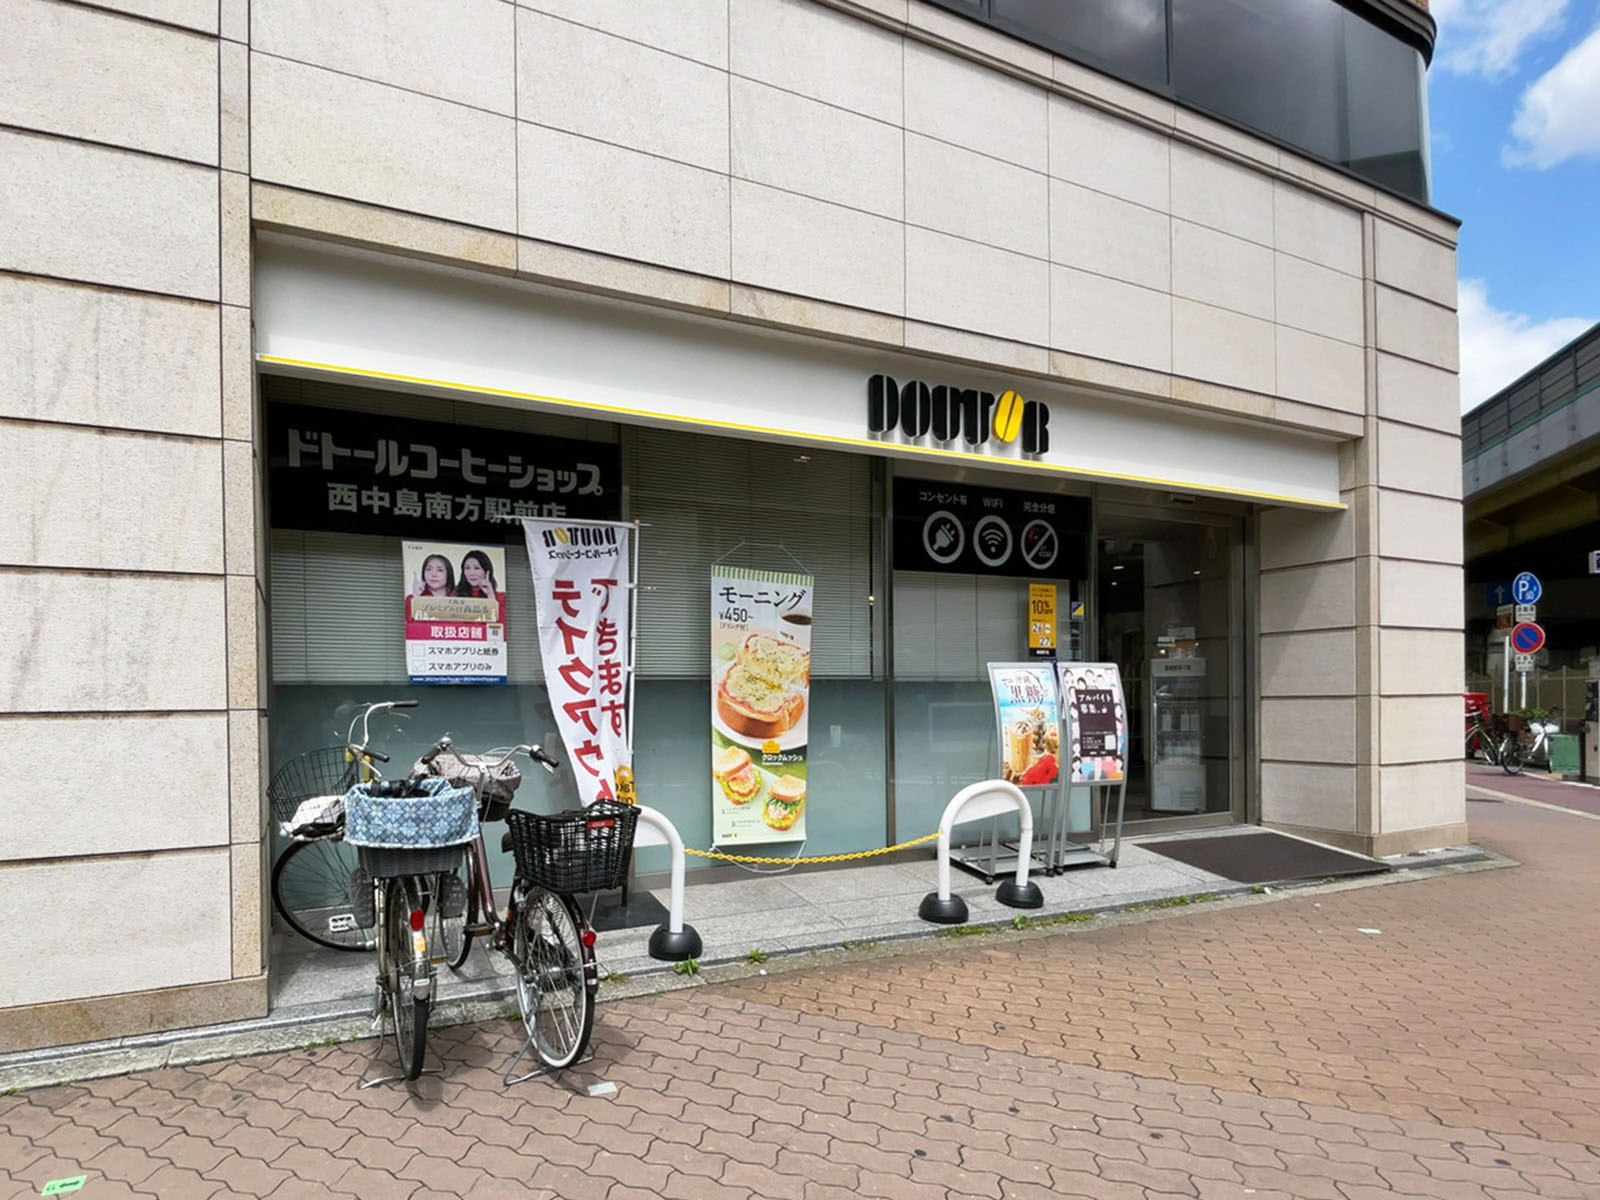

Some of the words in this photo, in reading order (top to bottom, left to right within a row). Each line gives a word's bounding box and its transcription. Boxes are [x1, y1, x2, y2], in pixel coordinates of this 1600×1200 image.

[868, 374, 1049, 454] DOUTOR
[288, 428, 603, 496] ドトールコーヒーショップ
[919, 491, 967, 506] コンセント有
[719, 586, 807, 611] モーニング
[1519, 580, 1529, 600] P
[431, 626, 482, 639] 取扱店舗
[428, 647, 499, 656] スマホアプリと紙券
[429, 663, 492, 671] スマホアプリのみ
